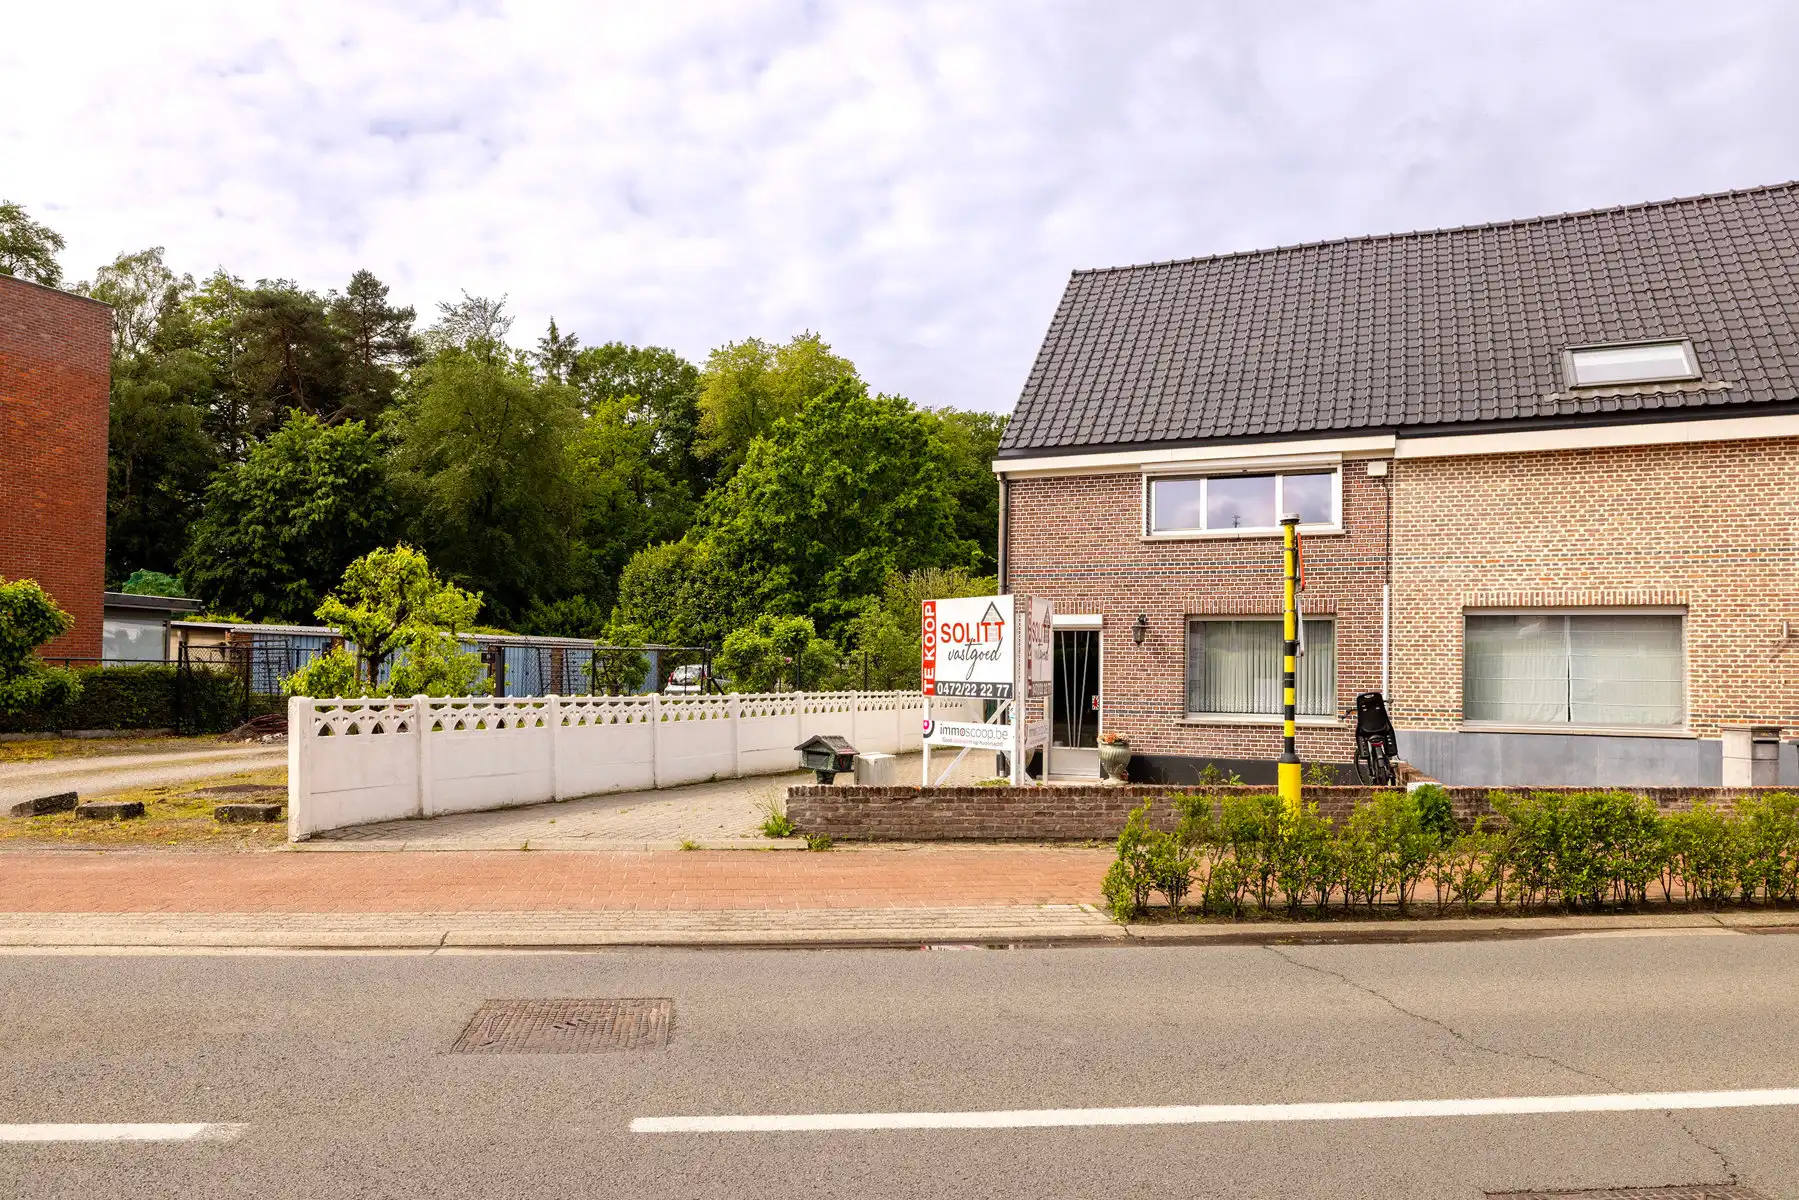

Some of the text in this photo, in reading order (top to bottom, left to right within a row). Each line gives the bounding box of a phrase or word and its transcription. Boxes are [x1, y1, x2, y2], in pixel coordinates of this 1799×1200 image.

[941, 621, 1005, 643] SOLITT
[924, 604, 936, 692] TE KOOP
[948, 637, 1004, 680] vastgoed
[937, 682, 1010, 699] 0472/22 22 77
[940, 724, 1009, 741] immoscoop.be
